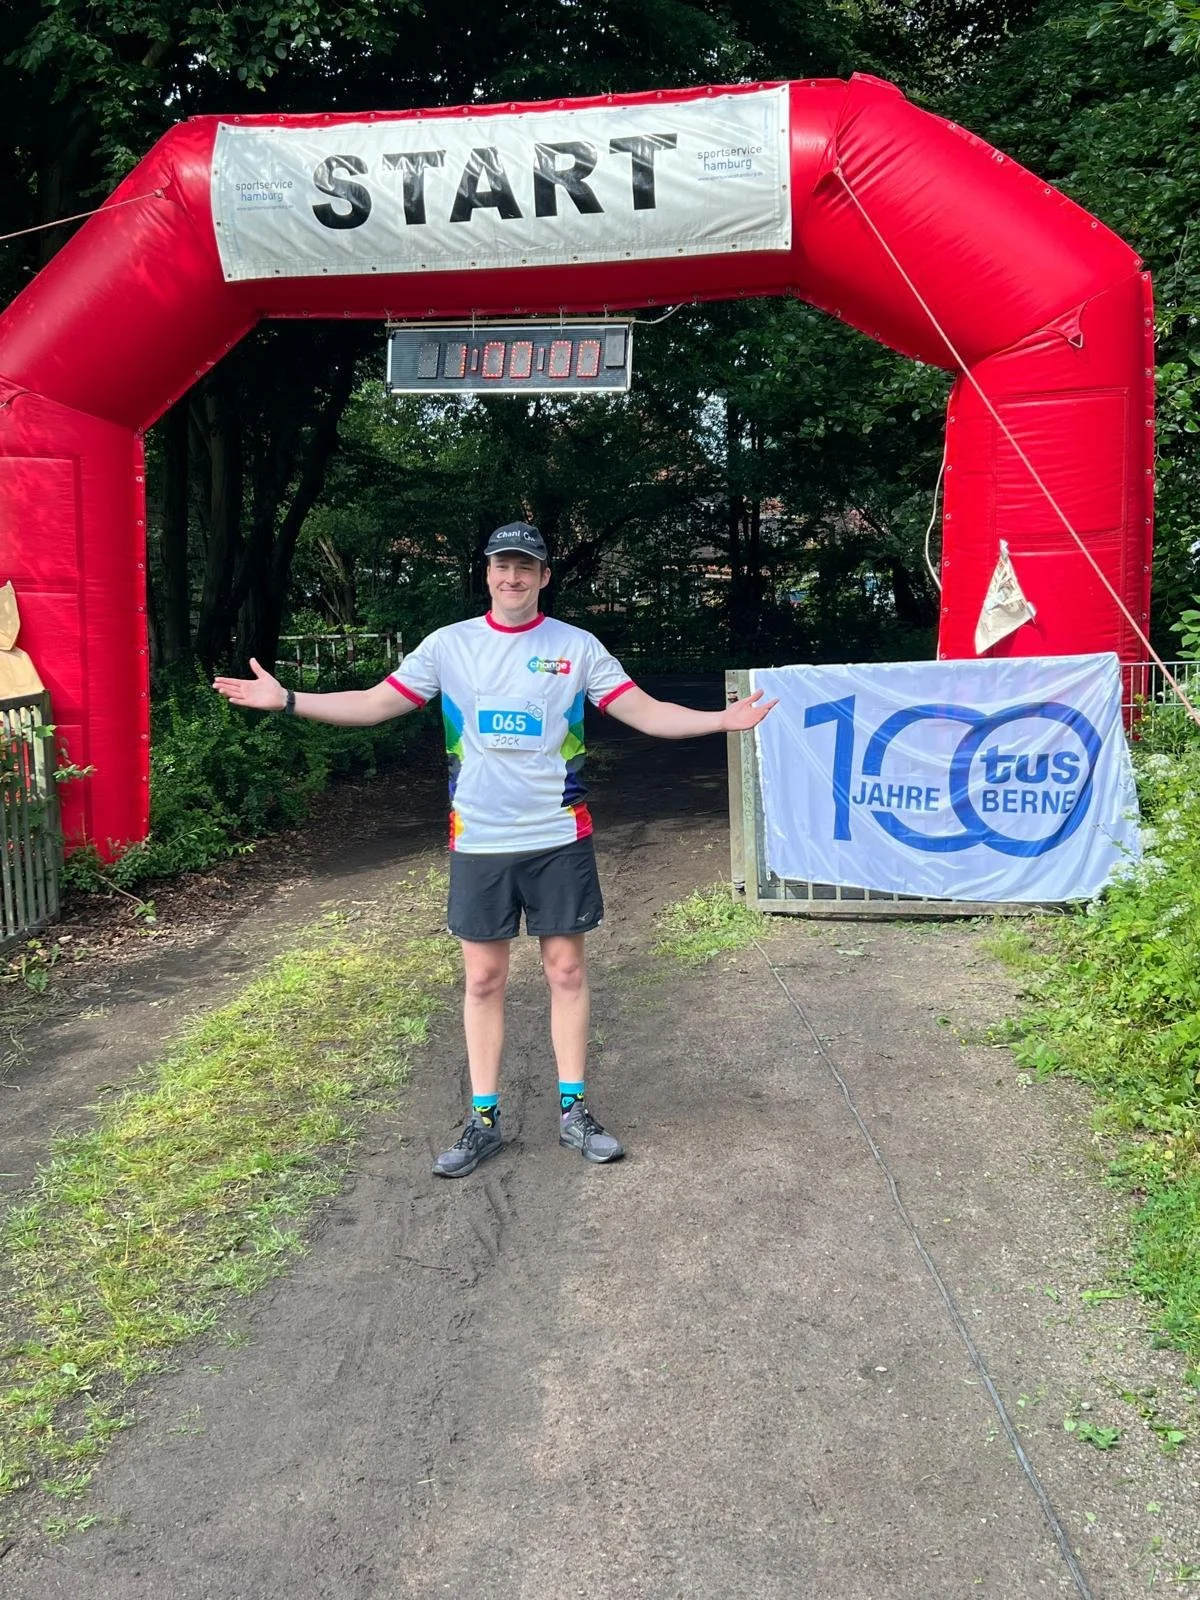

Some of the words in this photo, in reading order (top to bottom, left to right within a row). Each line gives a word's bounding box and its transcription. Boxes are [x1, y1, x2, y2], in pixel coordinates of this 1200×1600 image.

[697, 146, 762, 164] sportservice
[703, 159, 752, 171] hamburg
[235, 180, 293, 194] sportservice
[312, 133, 677, 229] START
[240, 191, 284, 202] hamburg
[530, 661, 568, 672] change
[492, 713, 527, 732] 065
[852, 781, 941, 812] JAHRE
[982, 789, 1076, 814] BERNE
